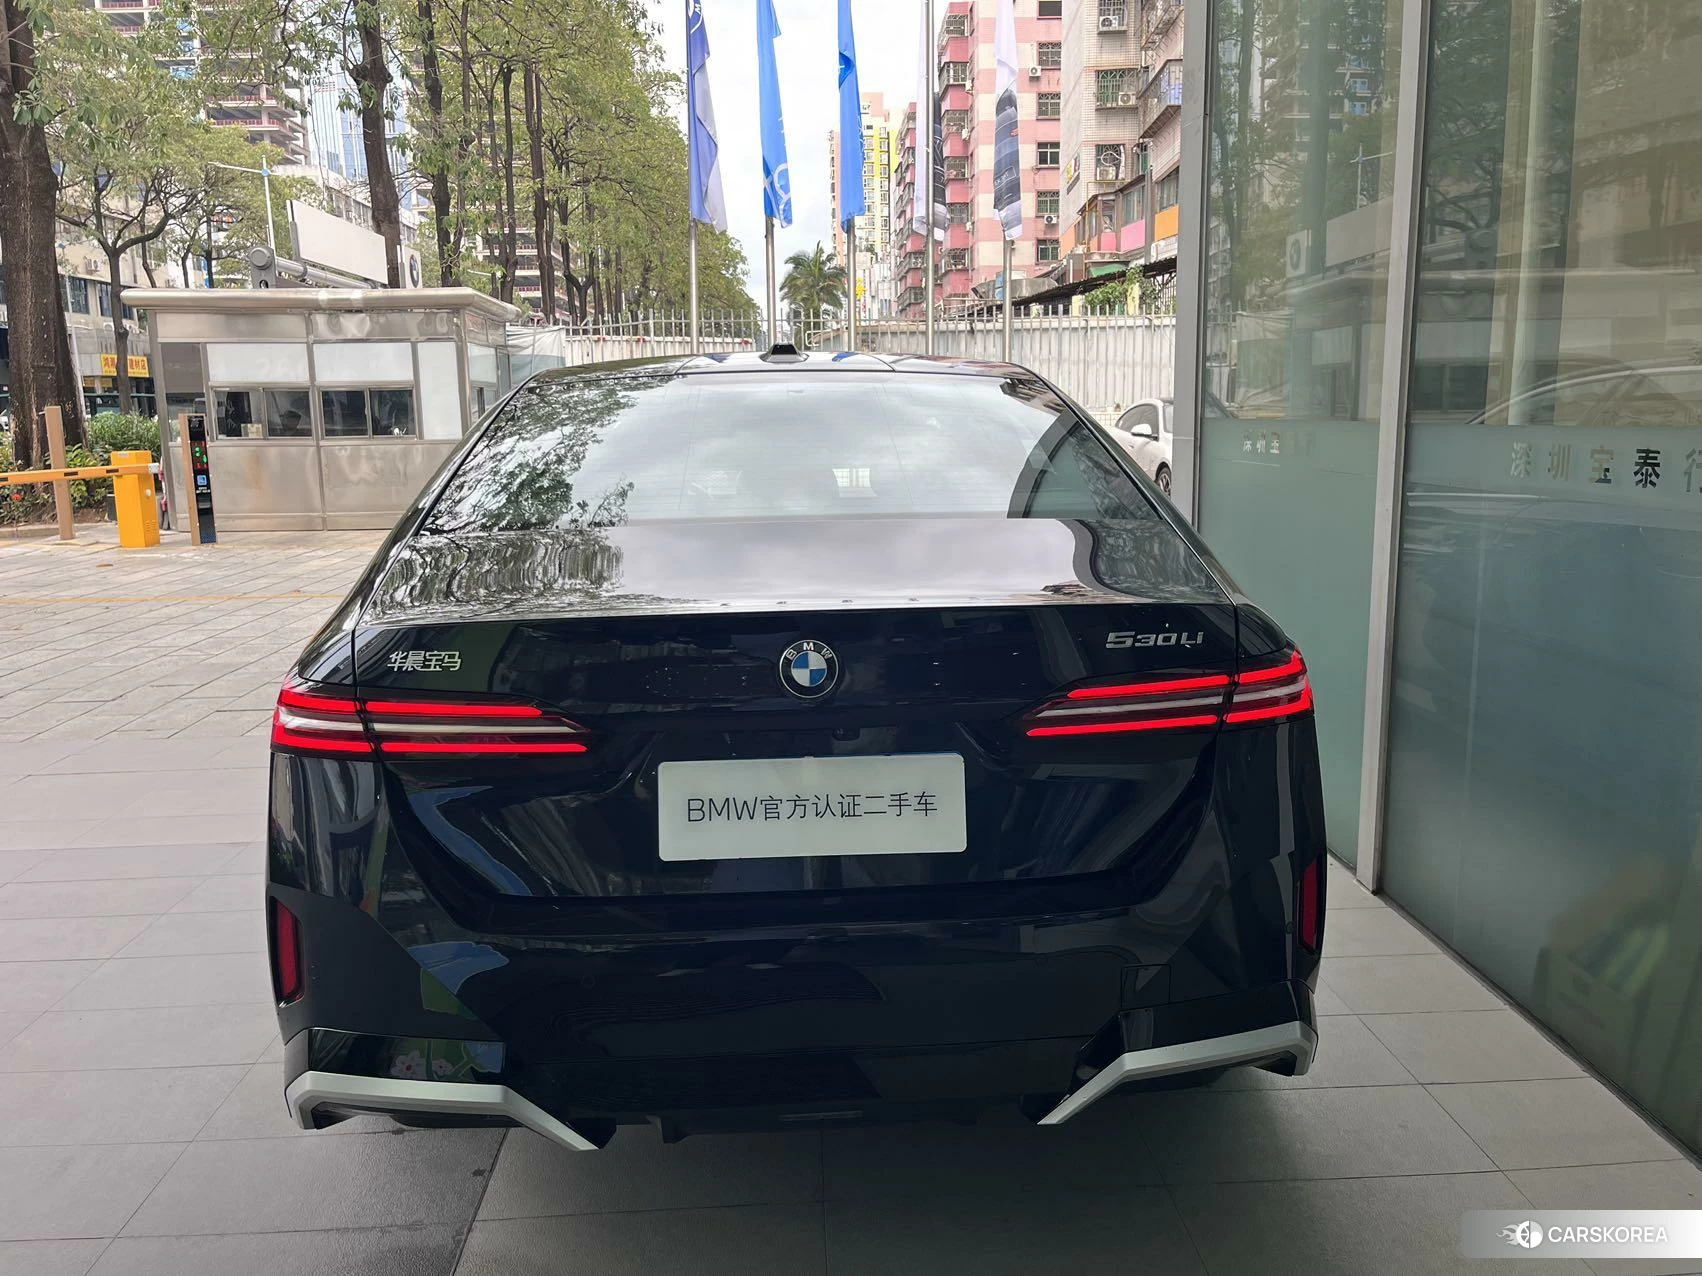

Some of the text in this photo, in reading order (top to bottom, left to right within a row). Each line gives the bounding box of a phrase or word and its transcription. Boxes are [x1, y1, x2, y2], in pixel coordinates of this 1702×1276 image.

[387, 650, 462, 672] 华晨宝马
[785, 641, 833, 660] BMW
[686, 790, 938, 822] BMW官方认证二手车
